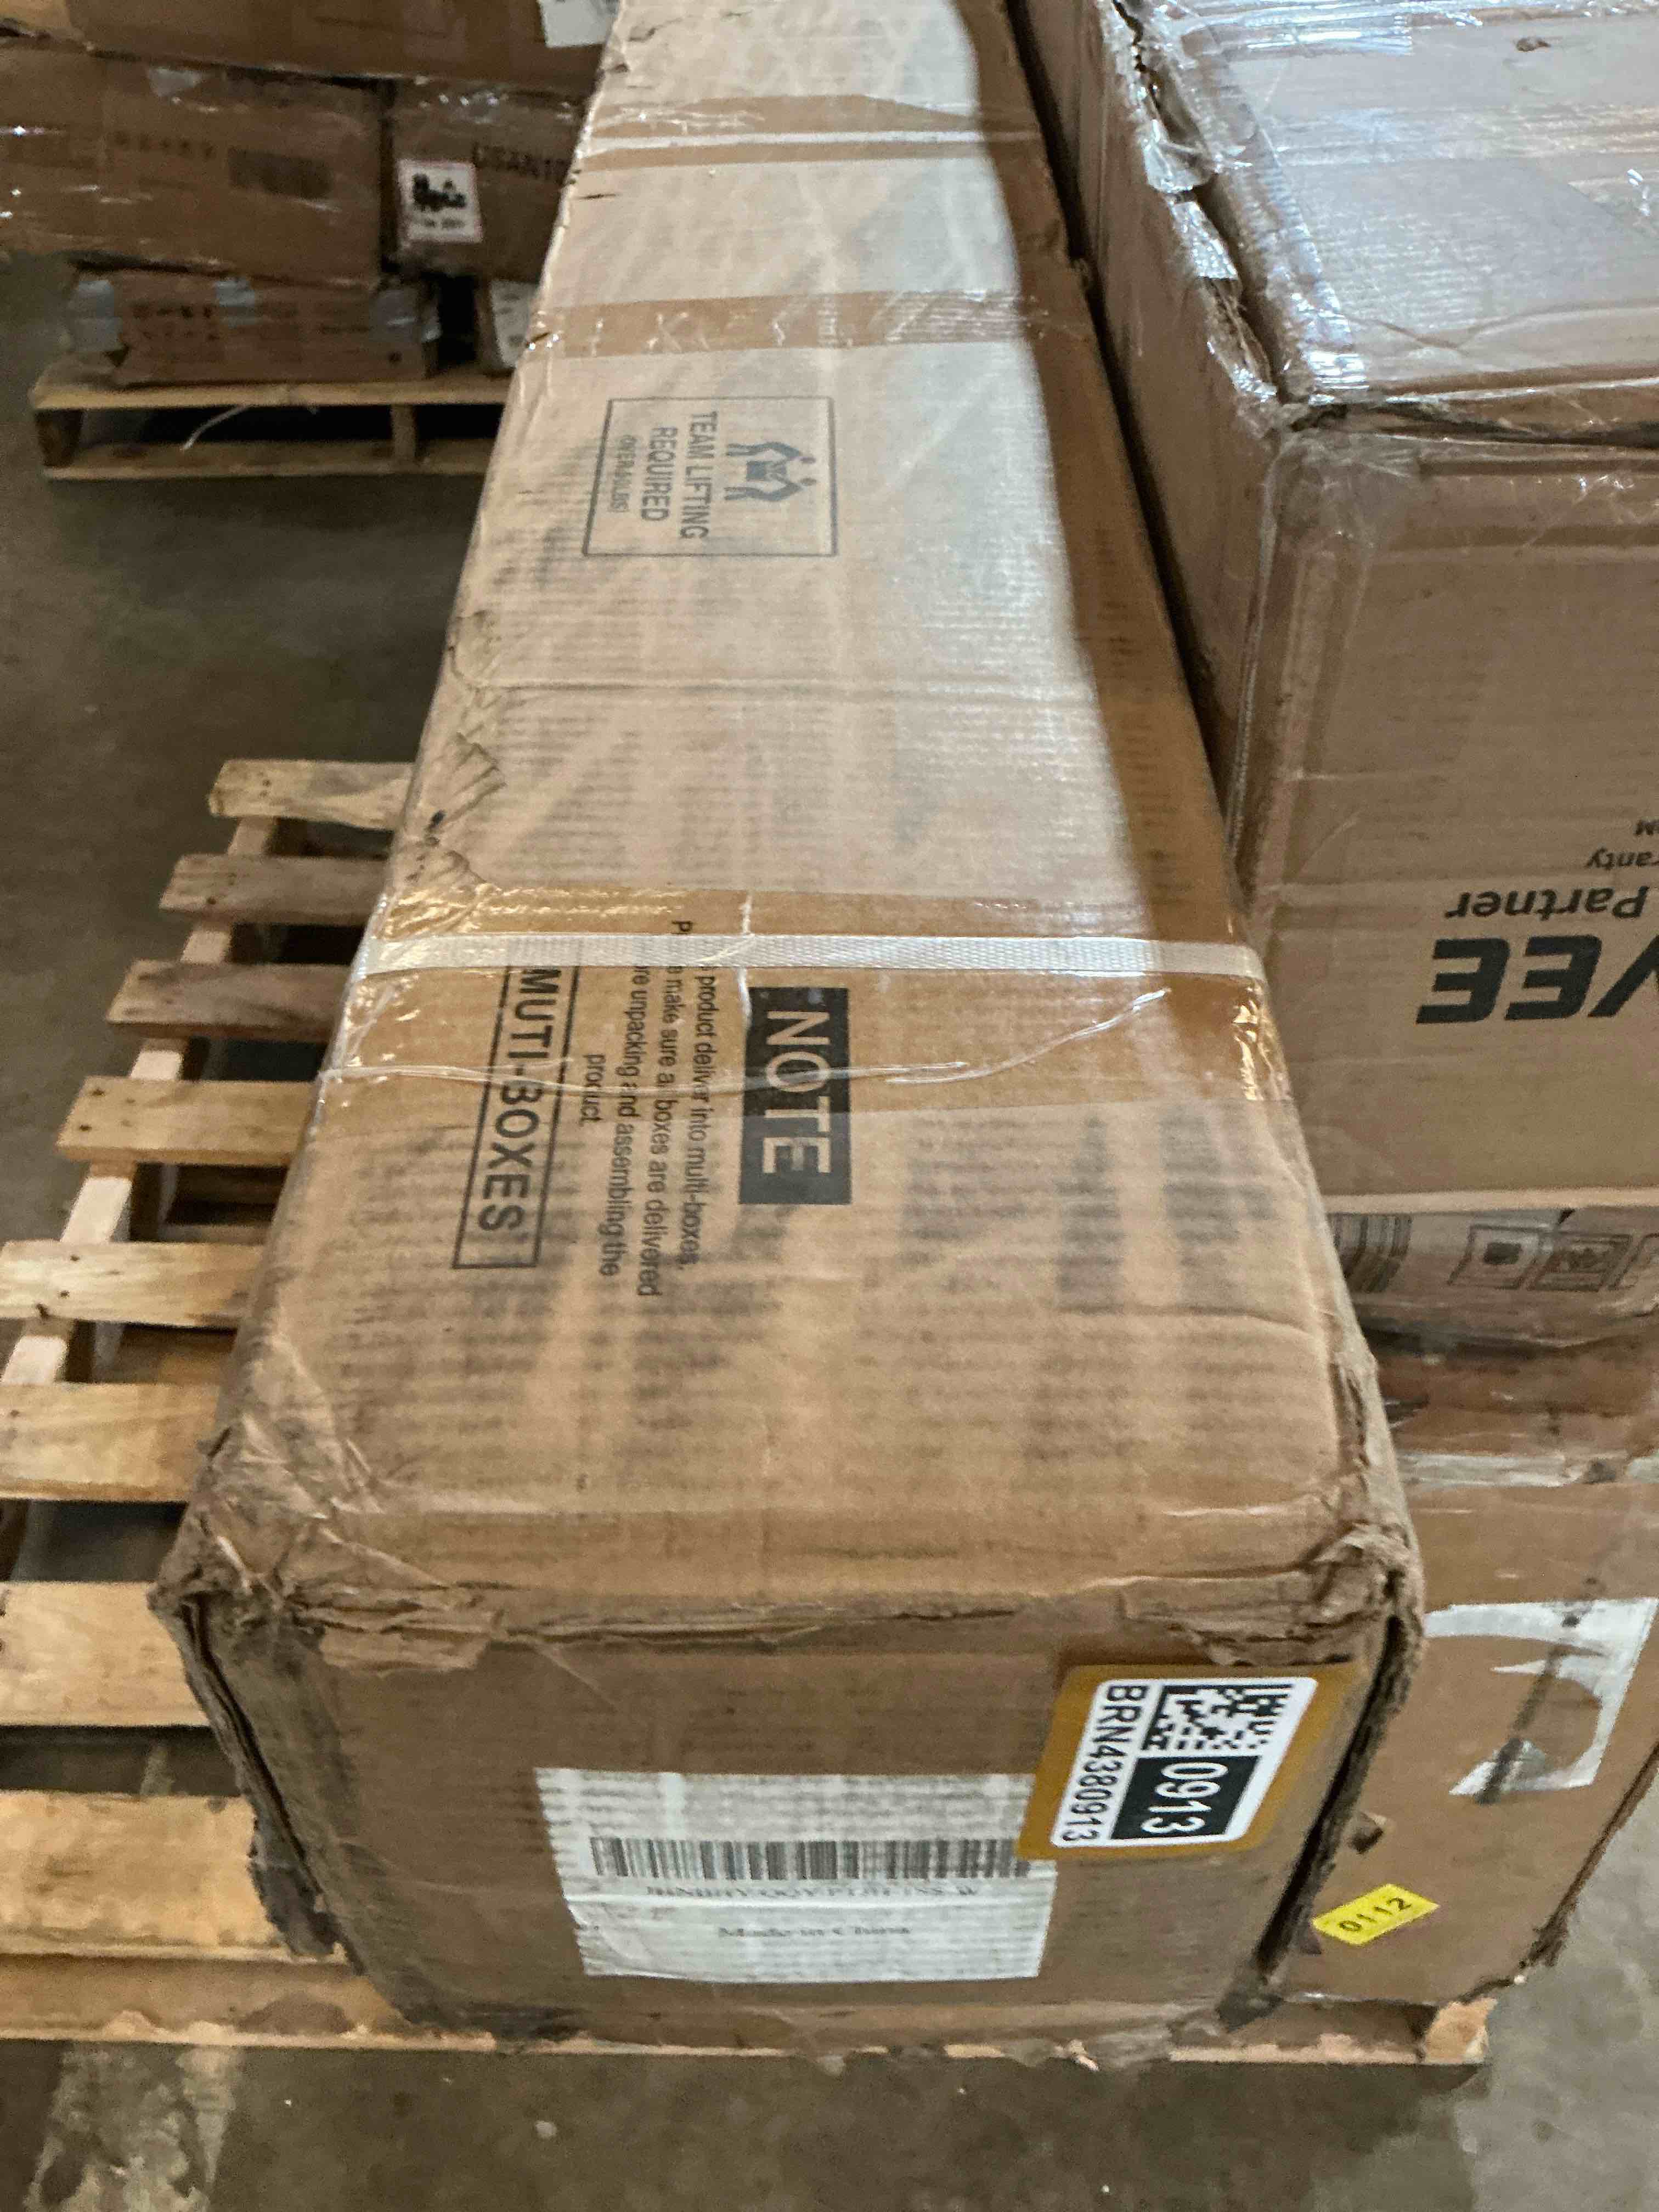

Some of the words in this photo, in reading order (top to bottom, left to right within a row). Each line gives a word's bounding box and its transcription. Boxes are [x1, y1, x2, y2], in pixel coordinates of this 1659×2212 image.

[687, 411, 718, 459] TEAM
[640, 426, 679, 521] REQUIRED
[680, 465, 714, 540] LIFTING
[1584, 847, 1659, 871] anty
[1444, 885, 1650, 922] Partner
[662, 979, 687, 1023] make
[693, 975, 720, 1037] product
[614, 991, 648, 1076] unpacking
[658, 1029, 678, 1066] sure
[477, 968, 561, 1232] MUTI-BOXES
[762, 1010, 831, 1174] NOTE
[650, 1099, 679, 1155] boxes
[687, 1108, 715, 1142] into
[597, 1124, 635, 1236] assembling
[646, 1161, 668, 1193] are
[599, 1242, 628, 1276] the
[637, 1199, 670, 1295] delivered
[1062, 1684, 1150, 1842] BRN4380913
[1140, 1761, 1229, 1835] 0913
[1338, 1896, 1413, 1932] 0112
